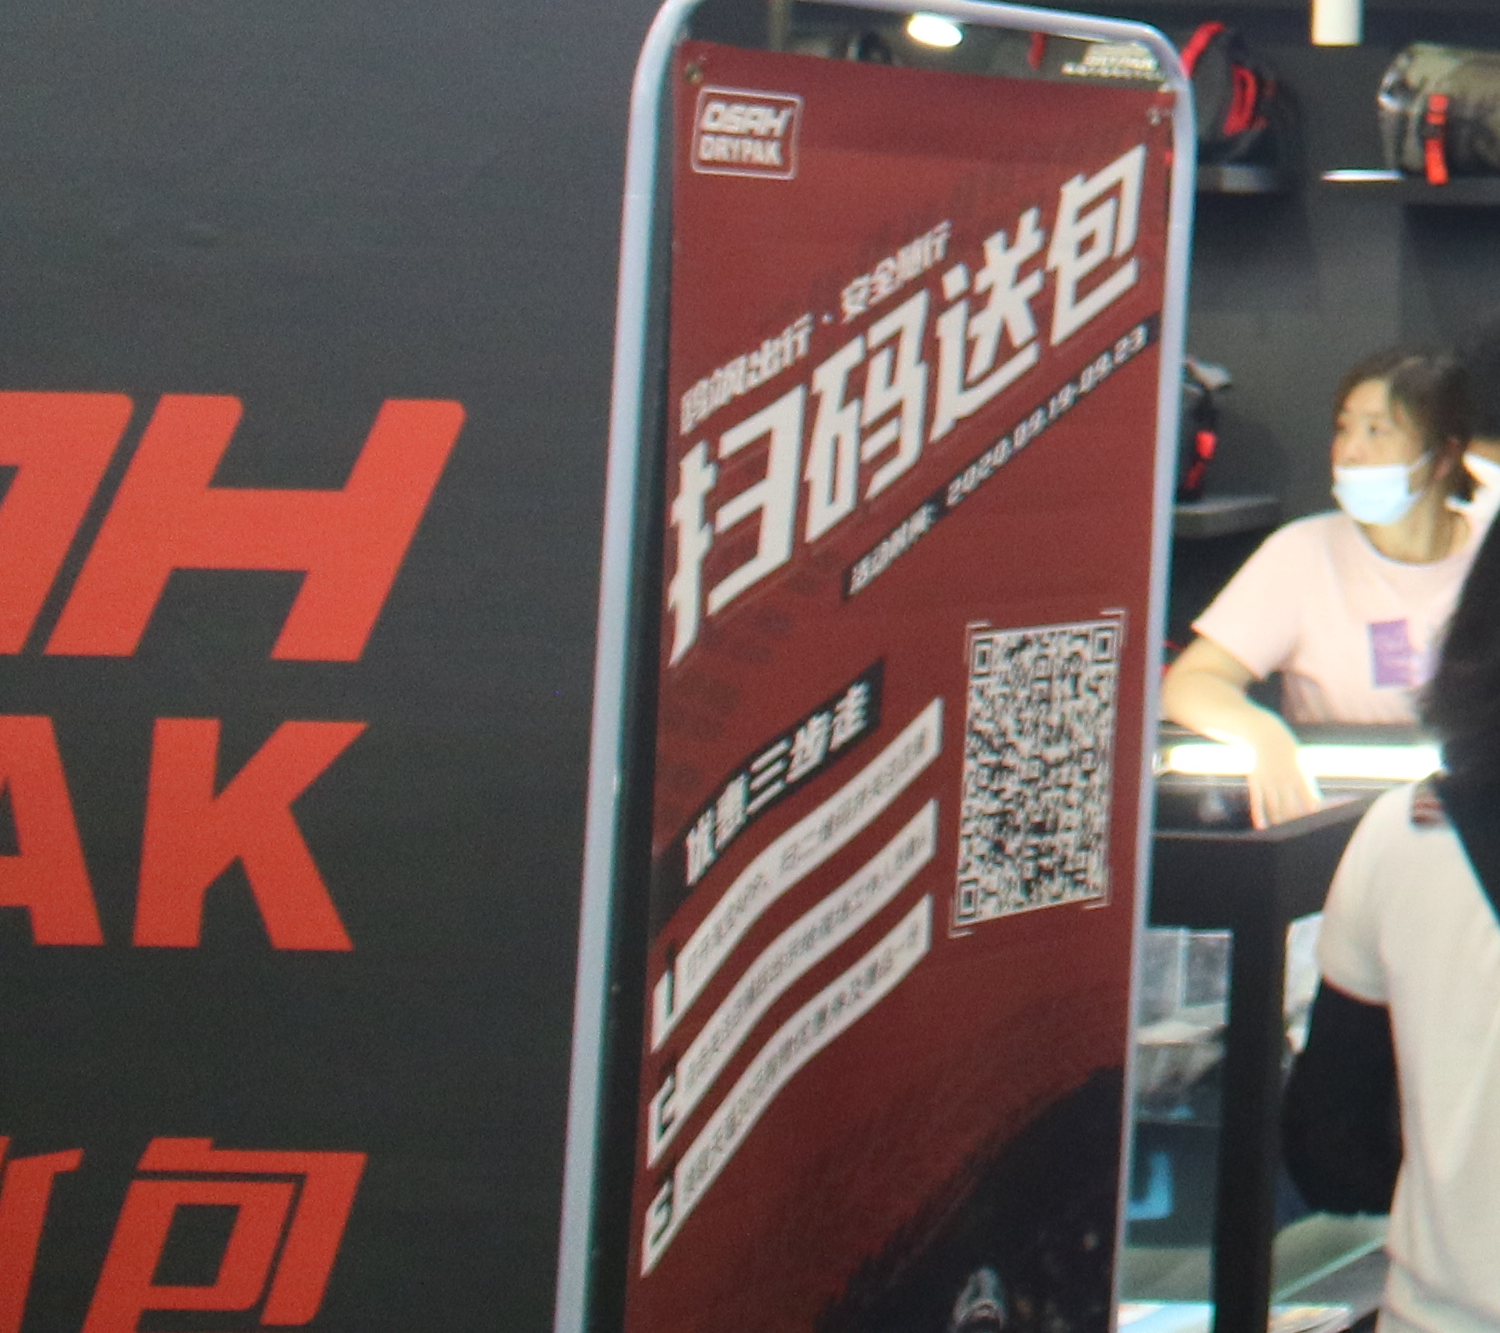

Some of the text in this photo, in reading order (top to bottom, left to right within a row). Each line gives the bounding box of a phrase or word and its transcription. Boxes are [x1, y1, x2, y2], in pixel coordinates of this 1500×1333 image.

[700, 102, 790, 137] OSAH
[699, 135, 783, 167] DRYPAK
[668, 143, 1148, 668] 扫码送包
